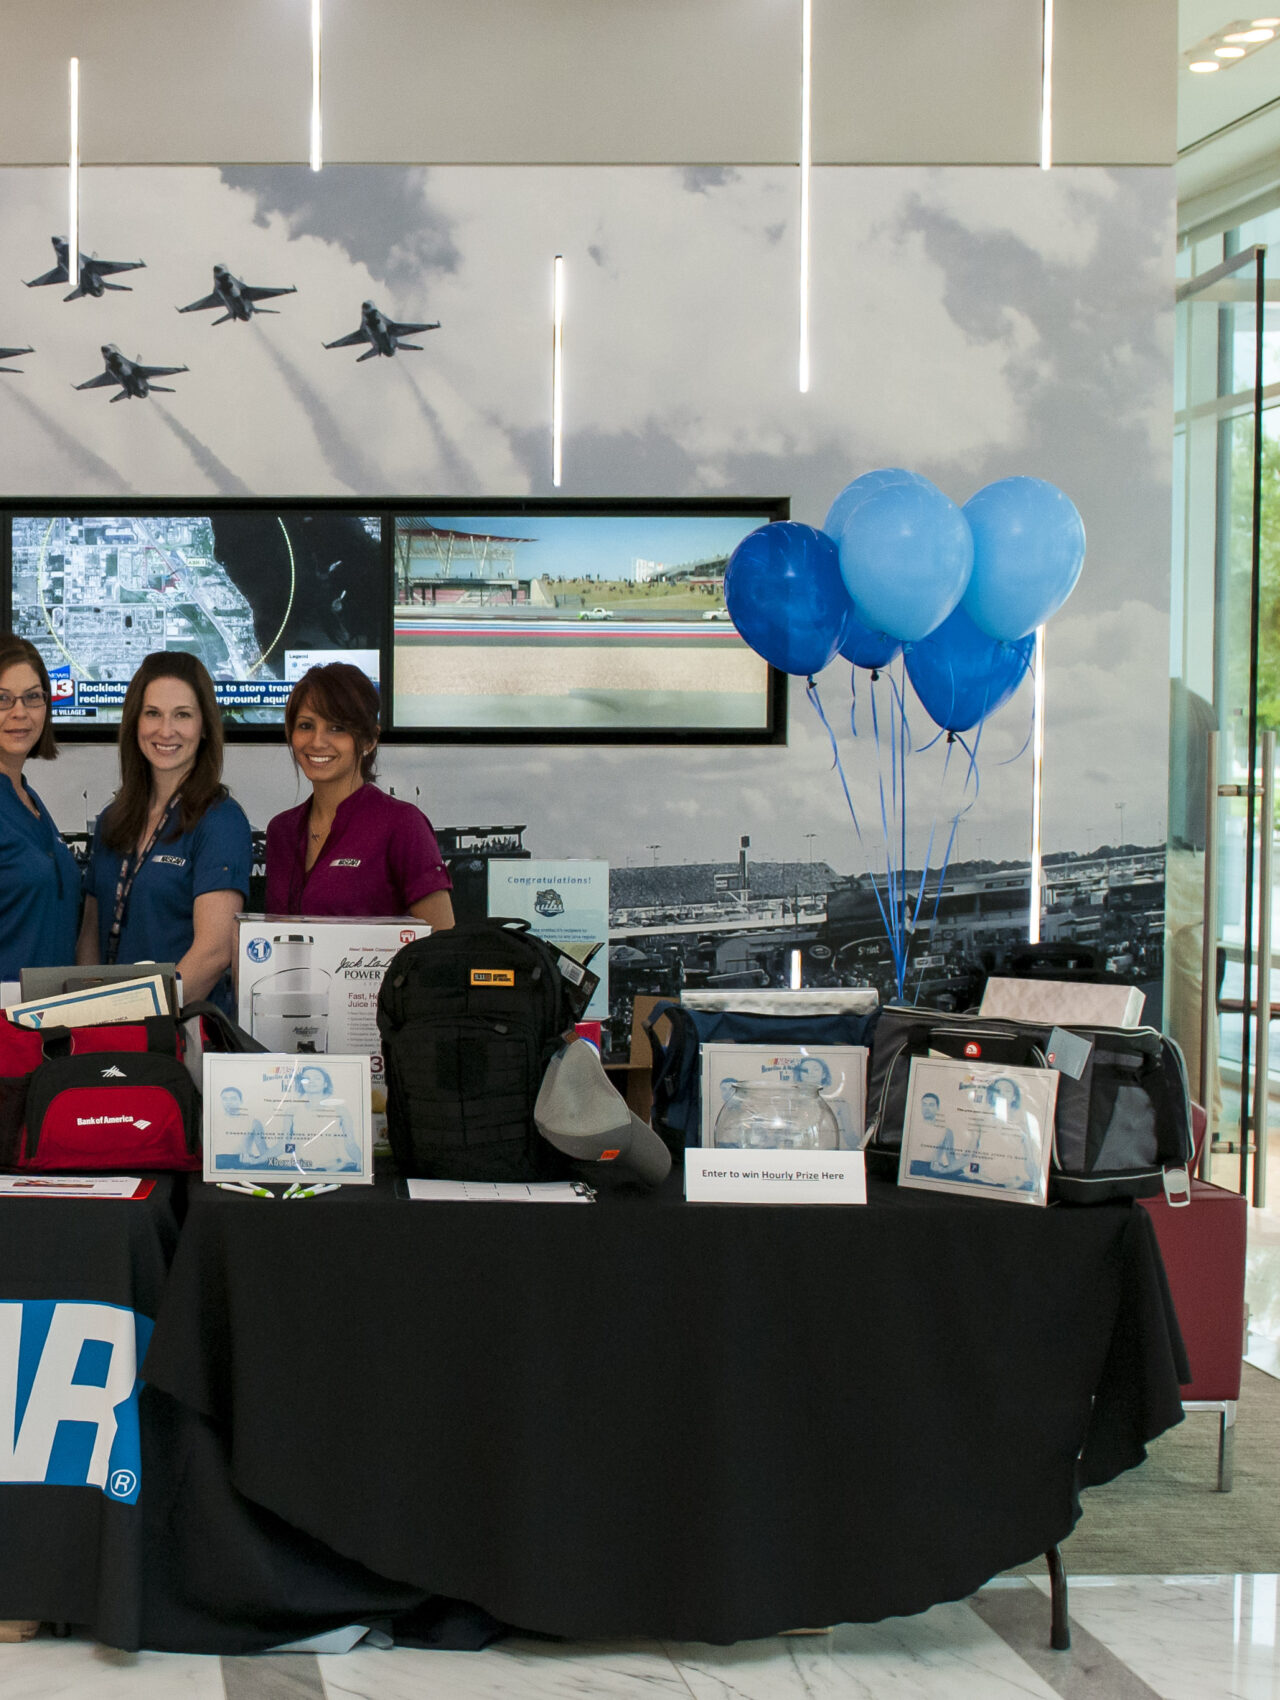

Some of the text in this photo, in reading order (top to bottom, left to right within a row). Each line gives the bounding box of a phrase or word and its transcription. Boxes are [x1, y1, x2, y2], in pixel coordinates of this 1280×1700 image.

[79, 683, 127, 694] Rockledg
[226, 684, 237, 692] to
[239, 684, 266, 692] store
[269, 684, 293, 692] treat
[79, 694, 125, 703] reclaime
[263, 694, 289, 705] aquif
[507, 876, 592, 886] Congratulations!
[344, 970, 381, 980] POWER
[348, 992, 367, 1000] Fast,
[76, 1114, 134, 1126] Bank of America
[702, 1169, 845, 1181] Enter to win Hourly Prize Here
